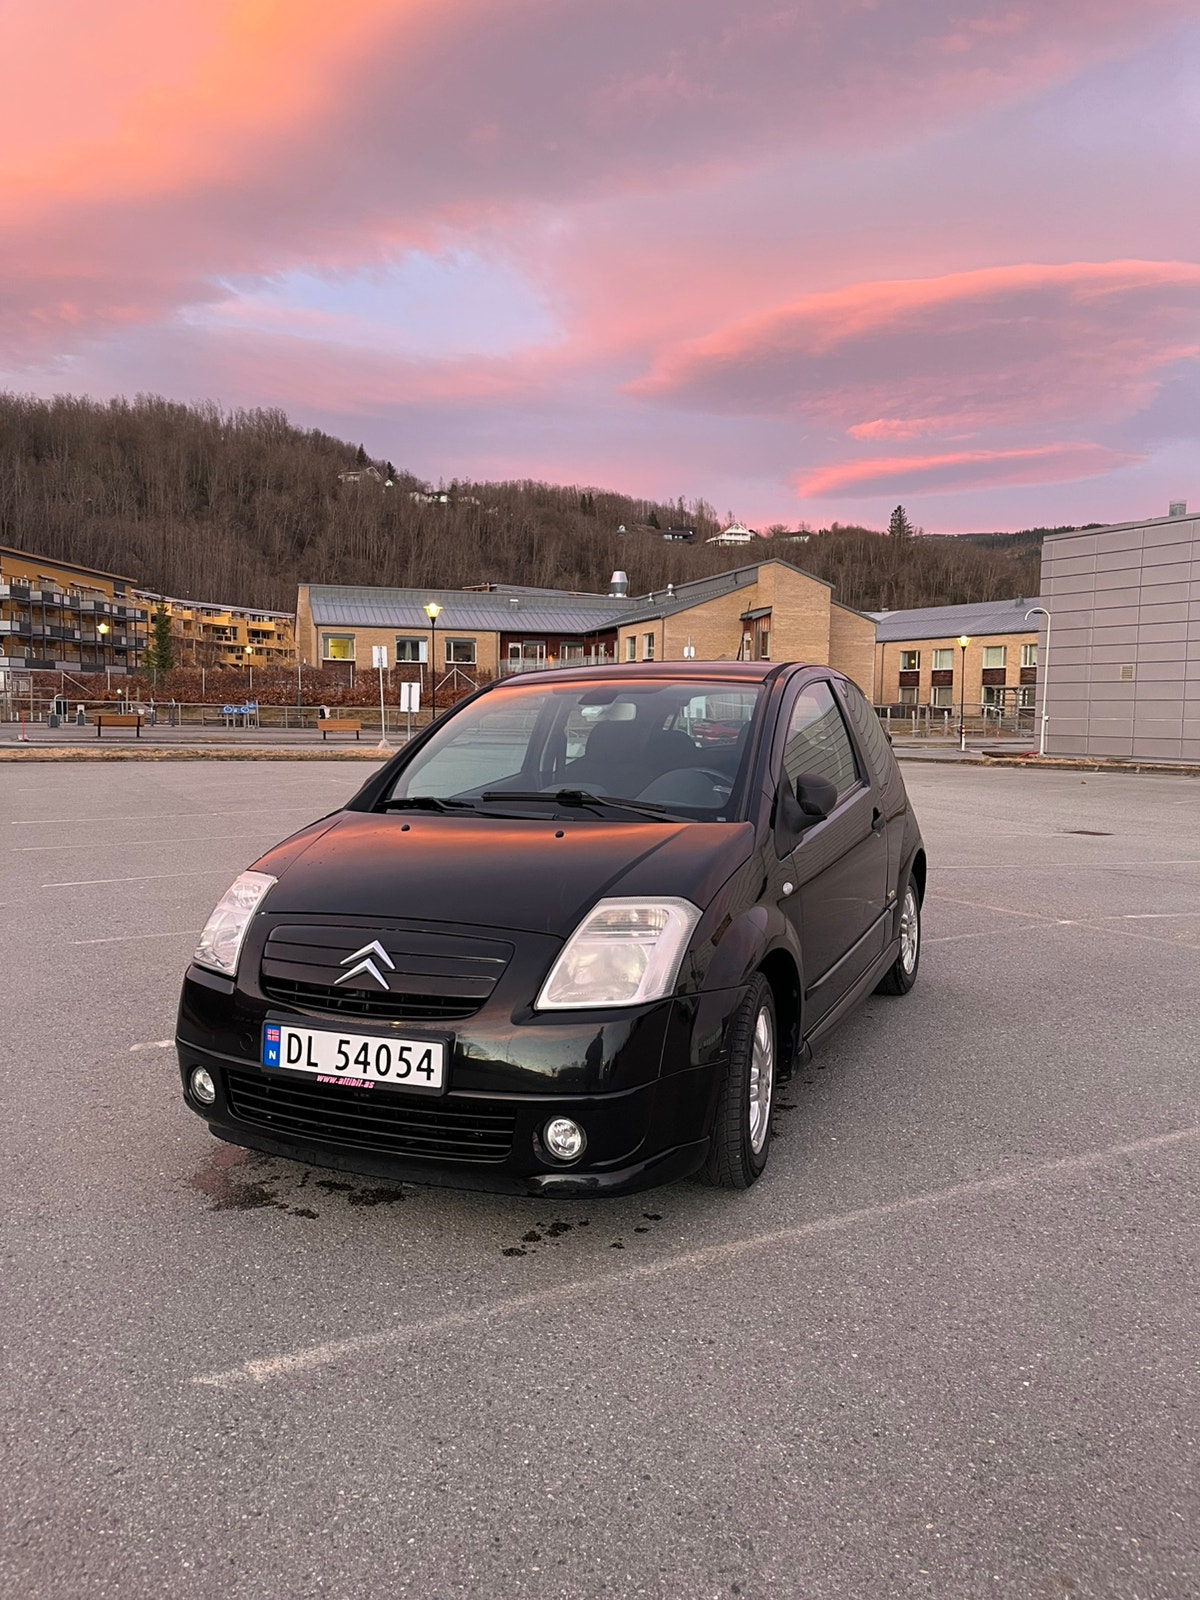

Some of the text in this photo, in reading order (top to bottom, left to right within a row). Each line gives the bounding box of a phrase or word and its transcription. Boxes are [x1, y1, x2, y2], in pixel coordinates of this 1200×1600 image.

[268, 1050, 276, 1060] N
[287, 1033, 434, 1081] DL 54054
